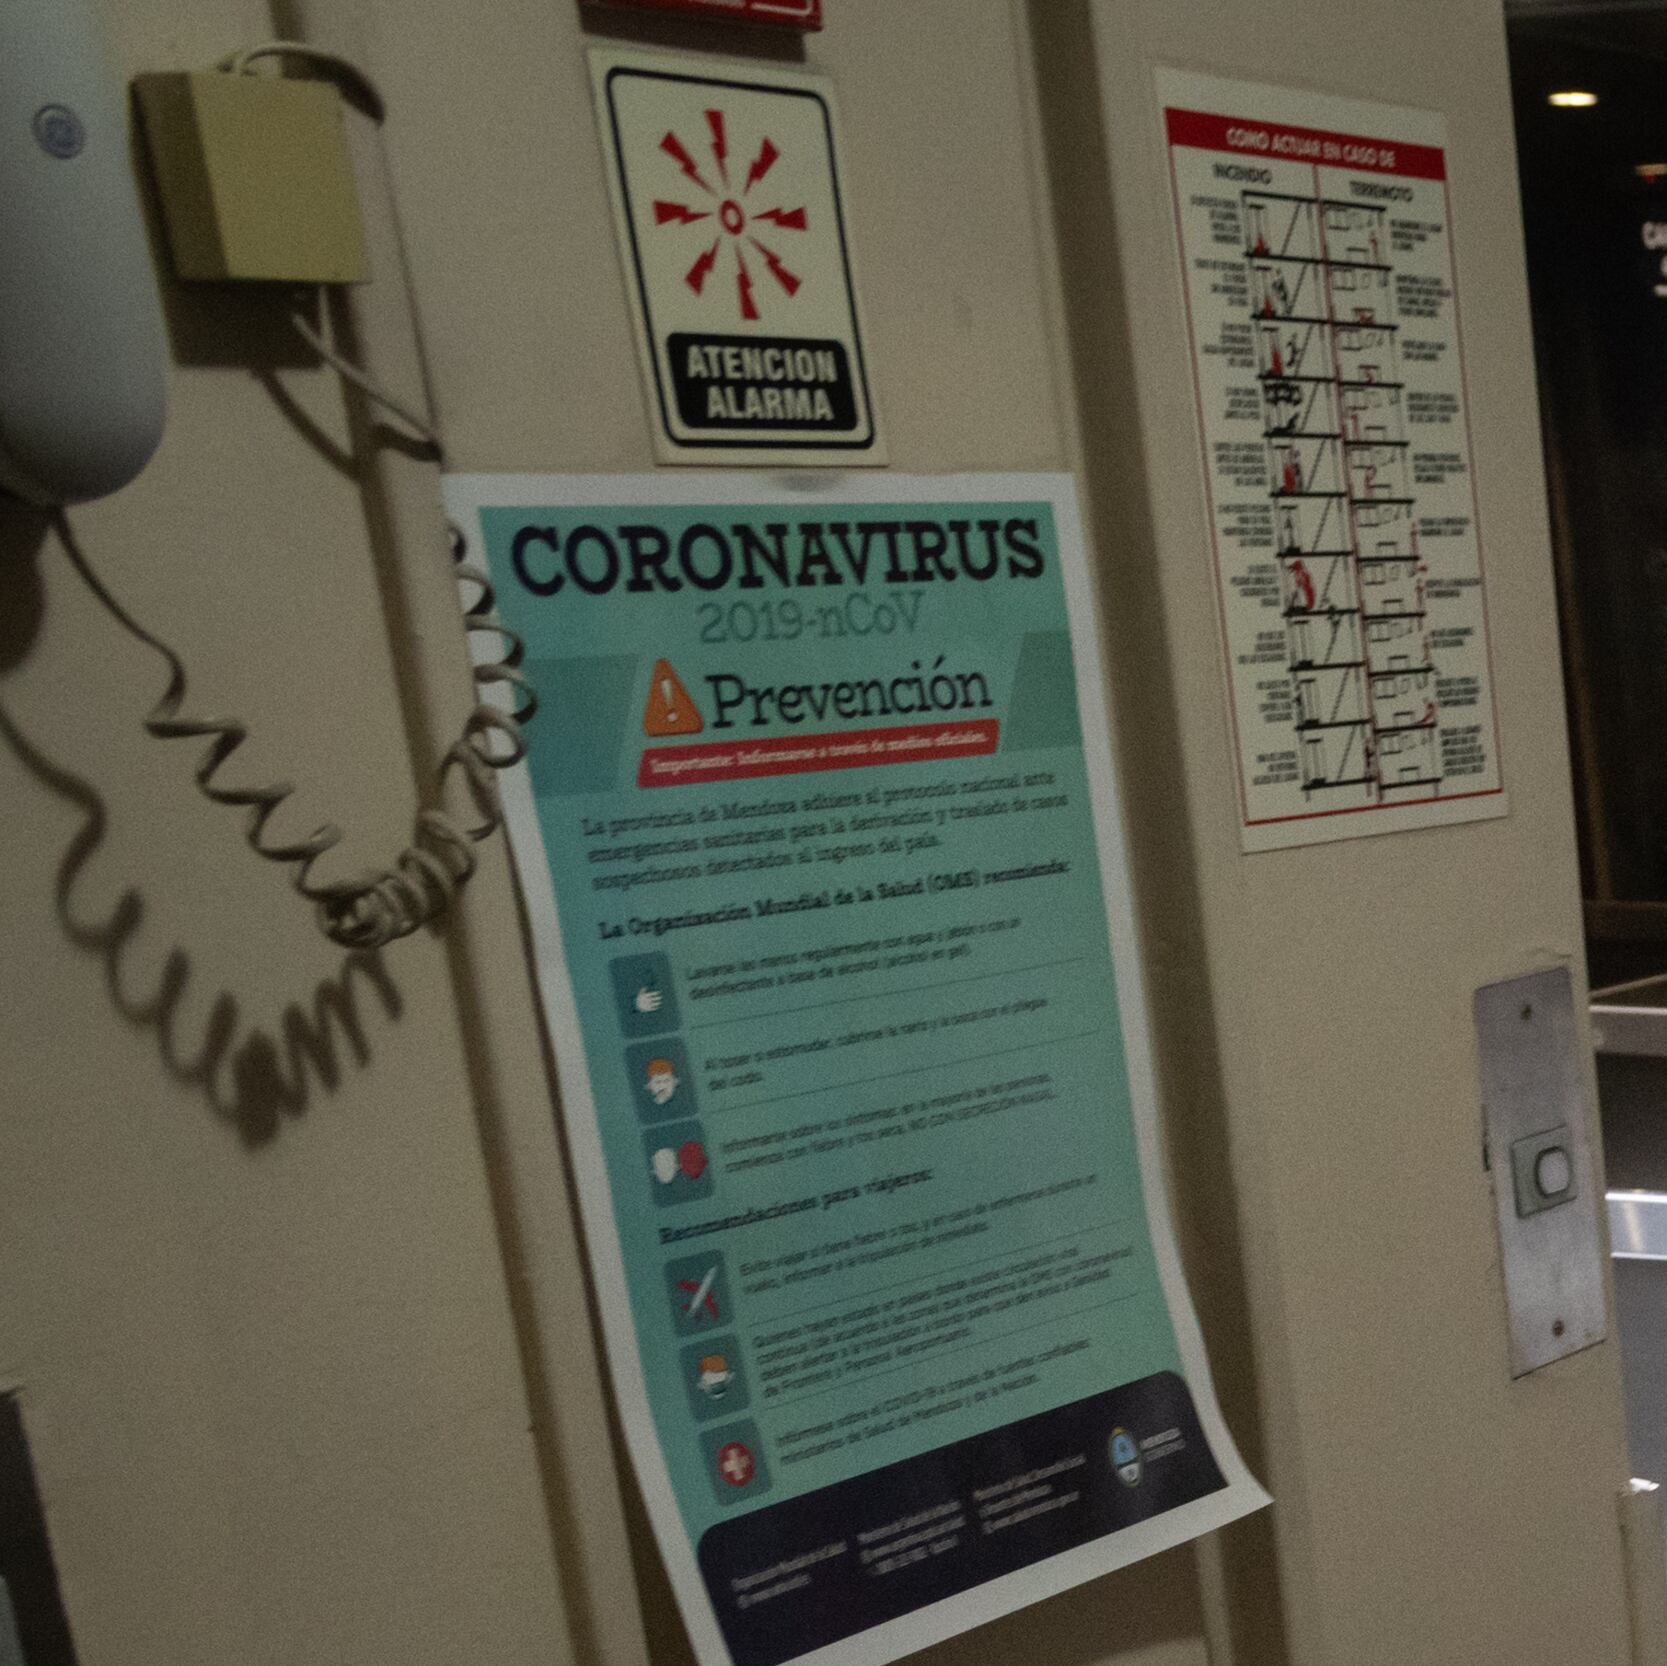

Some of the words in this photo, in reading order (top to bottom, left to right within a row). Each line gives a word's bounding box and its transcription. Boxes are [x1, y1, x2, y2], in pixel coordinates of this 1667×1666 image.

[1225, 126, 1270, 150] COMO
[1343, 144, 1379, 166] CASO
[1379, 149, 1397, 168] DE
[1212, 163, 1272, 185] INCENDIO
[687, 345, 837, 385] ATENCION
[706, 384, 835, 422] ALARMA
[511, 518, 1045, 596] CORONAVIRUS
[698, 593, 925, 645] 2019-nCoV
[705, 654, 996, 730] Prevención
[600, 922, 623, 938] La
[628, 903, 751, 935] Organización
[756, 891, 829, 915] Mundial
[833, 888, 854, 904] de
[858, 885, 873, 901] la
[878, 877, 923, 898] Salud
[928, 869, 978, 895] (OMS)
[983, 858, 1068, 883] recomienda:
[659, 1197, 818, 1242] Recomendaciones
[822, 1186, 860, 1209] para
[865, 1169, 932, 1194] viajeros:
